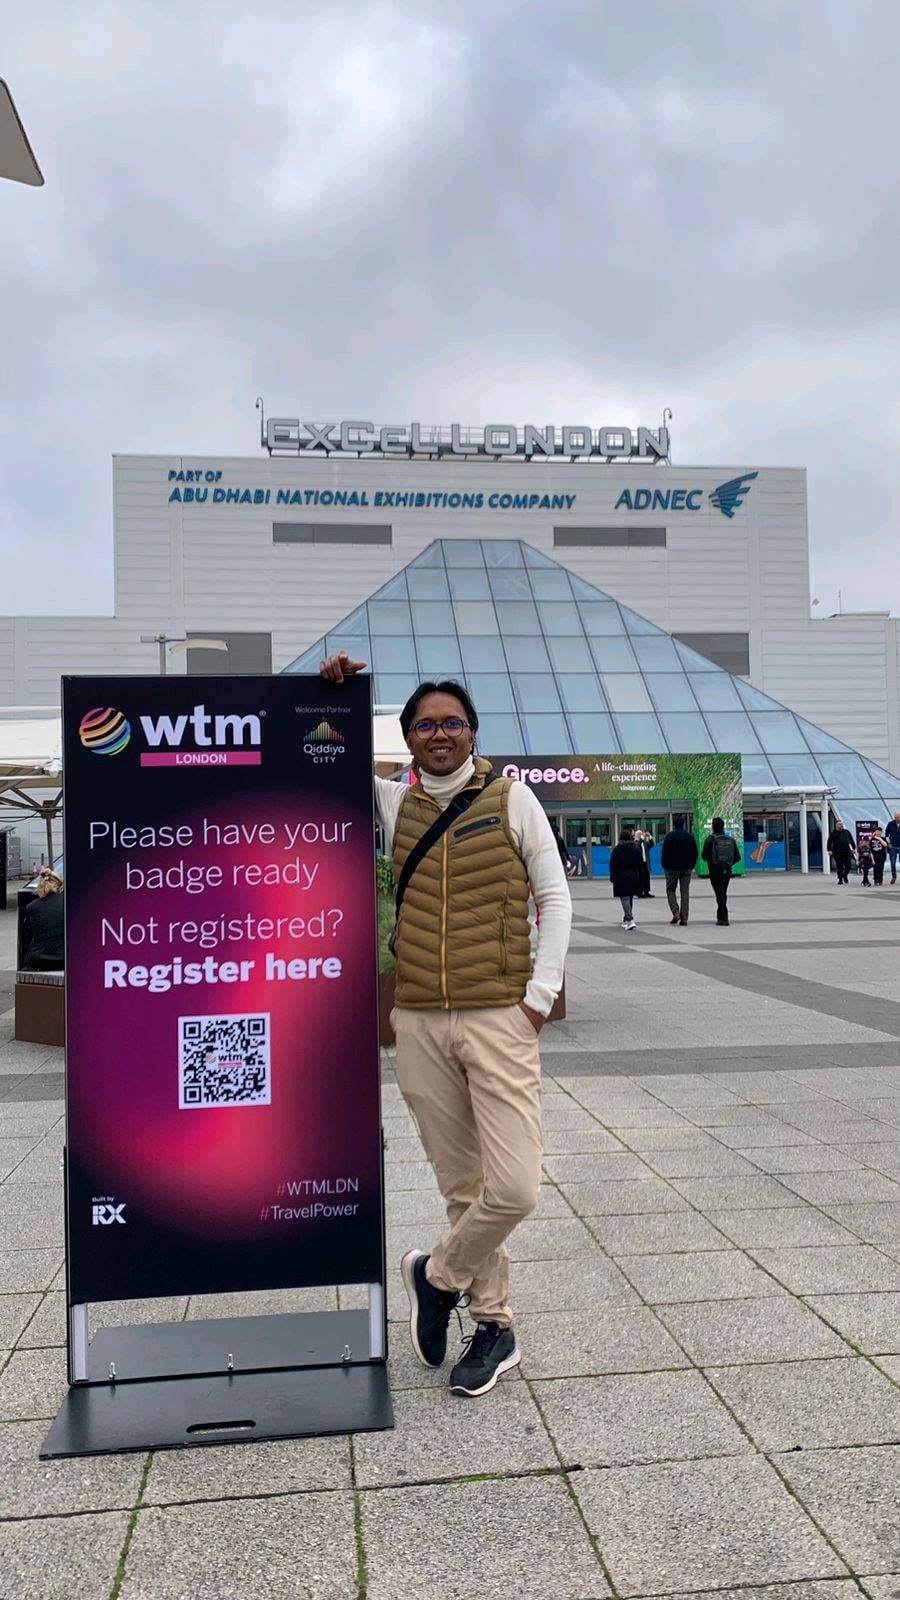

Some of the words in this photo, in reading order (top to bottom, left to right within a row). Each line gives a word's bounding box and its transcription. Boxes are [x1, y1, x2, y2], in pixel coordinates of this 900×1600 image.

[450, 423, 669, 457] LONDON
[168, 470, 202, 481] PART
[204, 471, 222, 482] OF
[168, 488, 208, 503] ABU
[212, 488, 271, 504] DHABI
[276, 489, 369, 506] NATIONAL
[373, 491, 484, 508] EXHIBITIONS
[488, 493, 576, 509] COMPANY
[614, 489, 702, 510] ADNEC
[175, 753, 227, 764] LONDON
[303, 743, 345, 756] Qiddiya
[312, 756, 336, 764] CITY
[593, 764, 600, 772] A
[601, 762, 657, 773] life-changing
[611, 773, 657, 783] experience
[89, 821, 193, 850] Please
[203, 819, 275, 845] have
[284, 820, 352, 849] your
[125, 860, 223, 893] badge
[233, 857, 319, 890] ready
[101, 917, 158, 946] Not
[168, 909, 343, 948] registered?
[103, 956, 255, 993] Register
[265, 953, 342, 981] here
[218, 1053, 243, 1062] wtm
[276, 1178, 359, 1196] #WTMLDN
[92, 1203, 127, 1225] RX
[260, 1203, 359, 1221] #TravelPower
